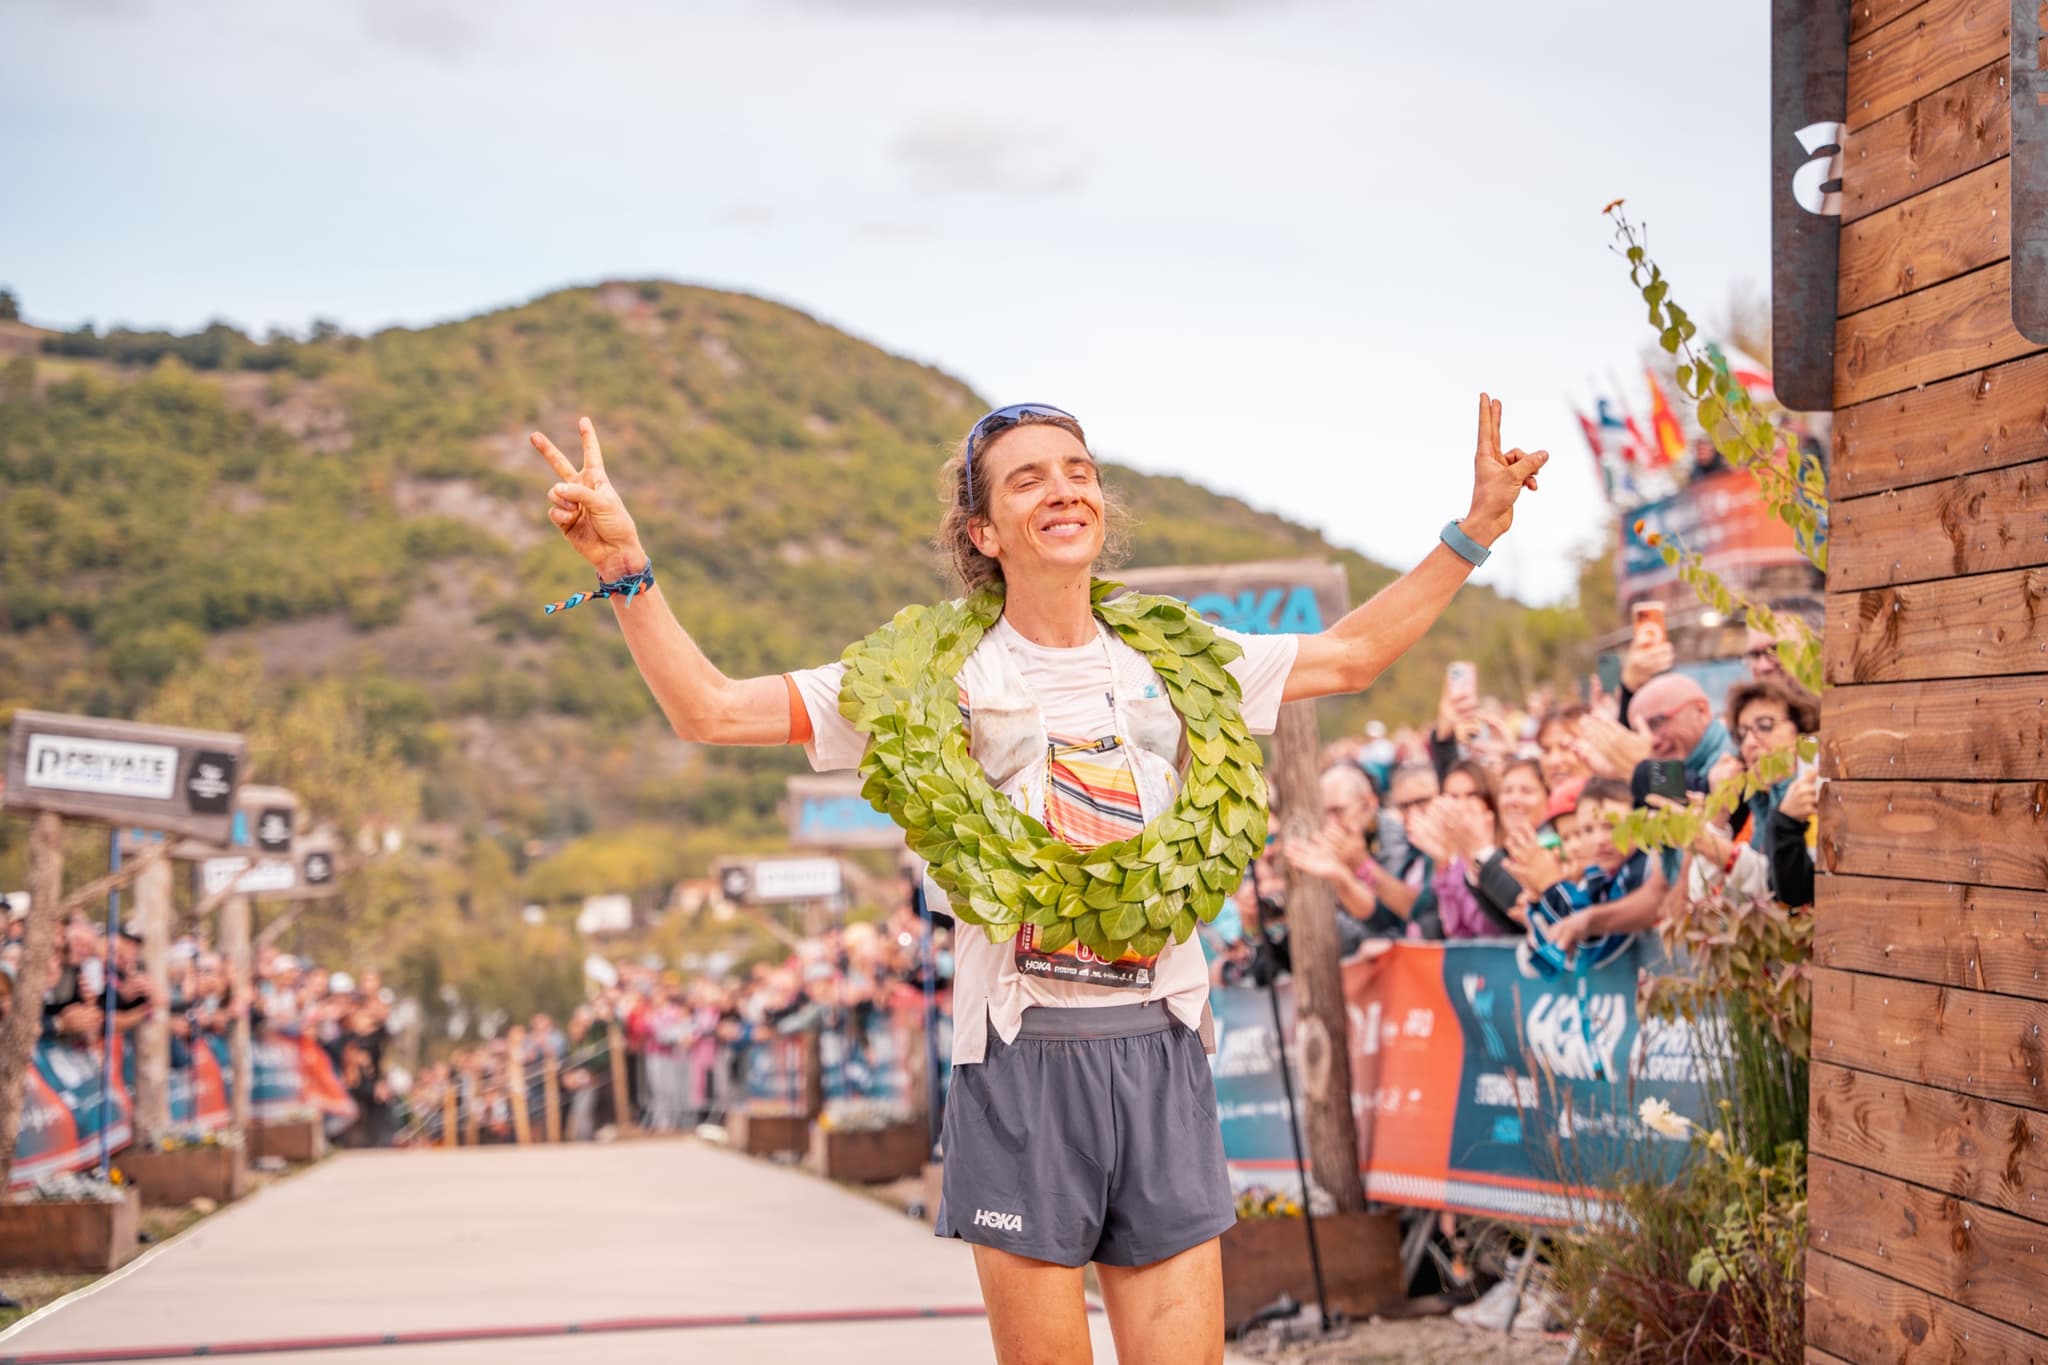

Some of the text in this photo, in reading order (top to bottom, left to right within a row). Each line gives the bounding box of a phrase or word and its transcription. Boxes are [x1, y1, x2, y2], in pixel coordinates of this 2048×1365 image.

[1180, 586, 1324, 635] OKA
[1025, 959, 1052, 972] HOKA
[974, 1208, 1022, 1232] HOKA
